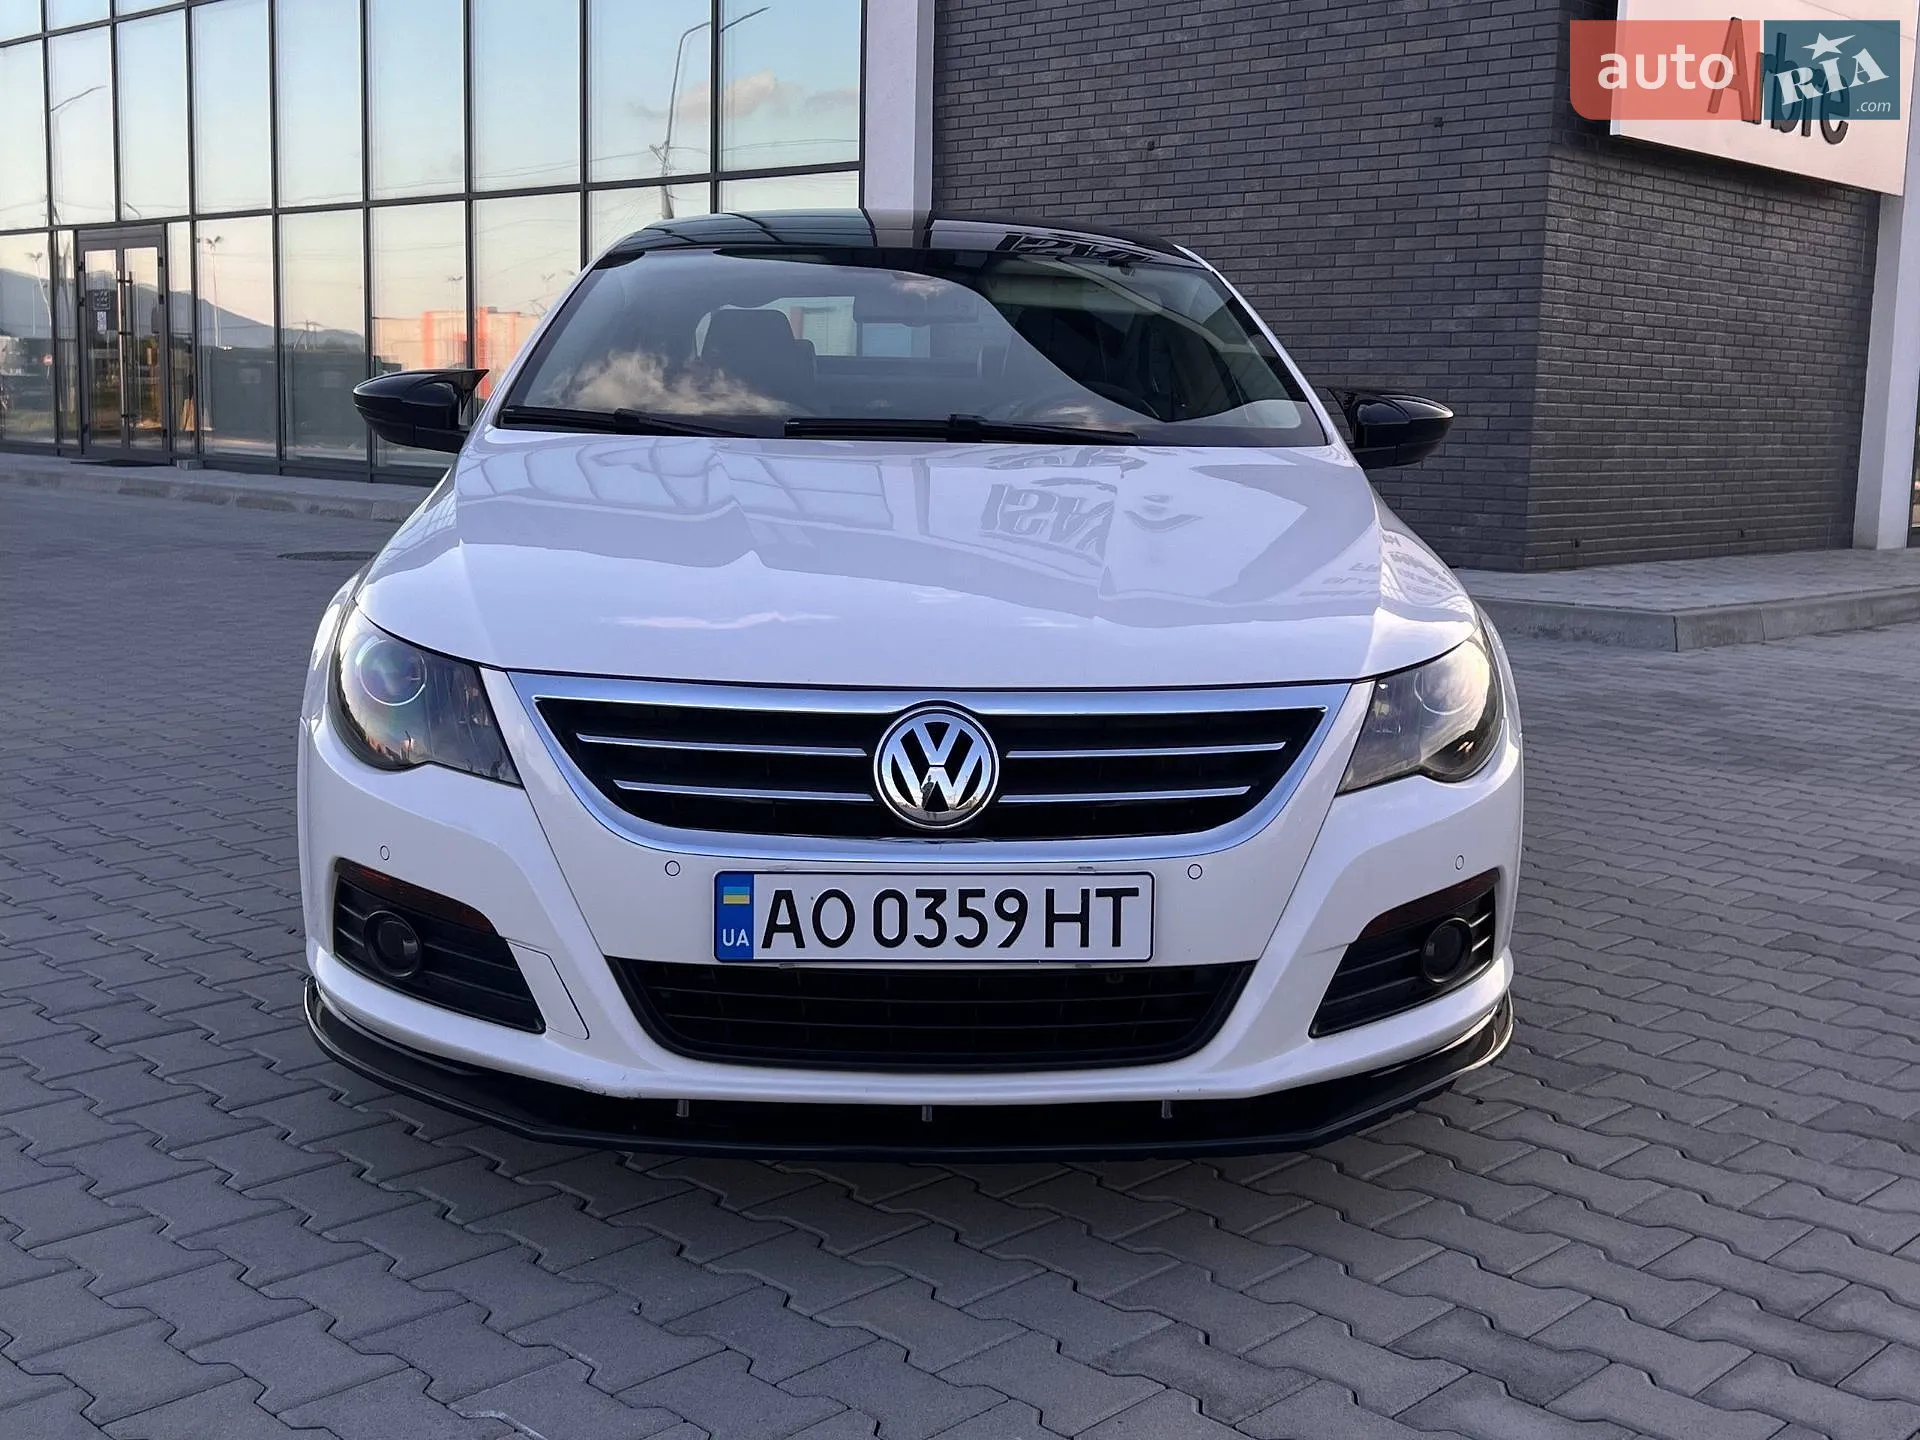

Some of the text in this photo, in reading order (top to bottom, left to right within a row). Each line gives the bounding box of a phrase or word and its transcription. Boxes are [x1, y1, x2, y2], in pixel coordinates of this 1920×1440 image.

[722, 928, 750, 948] UA
[761, 887, 1140, 949] AO 0359 HT
